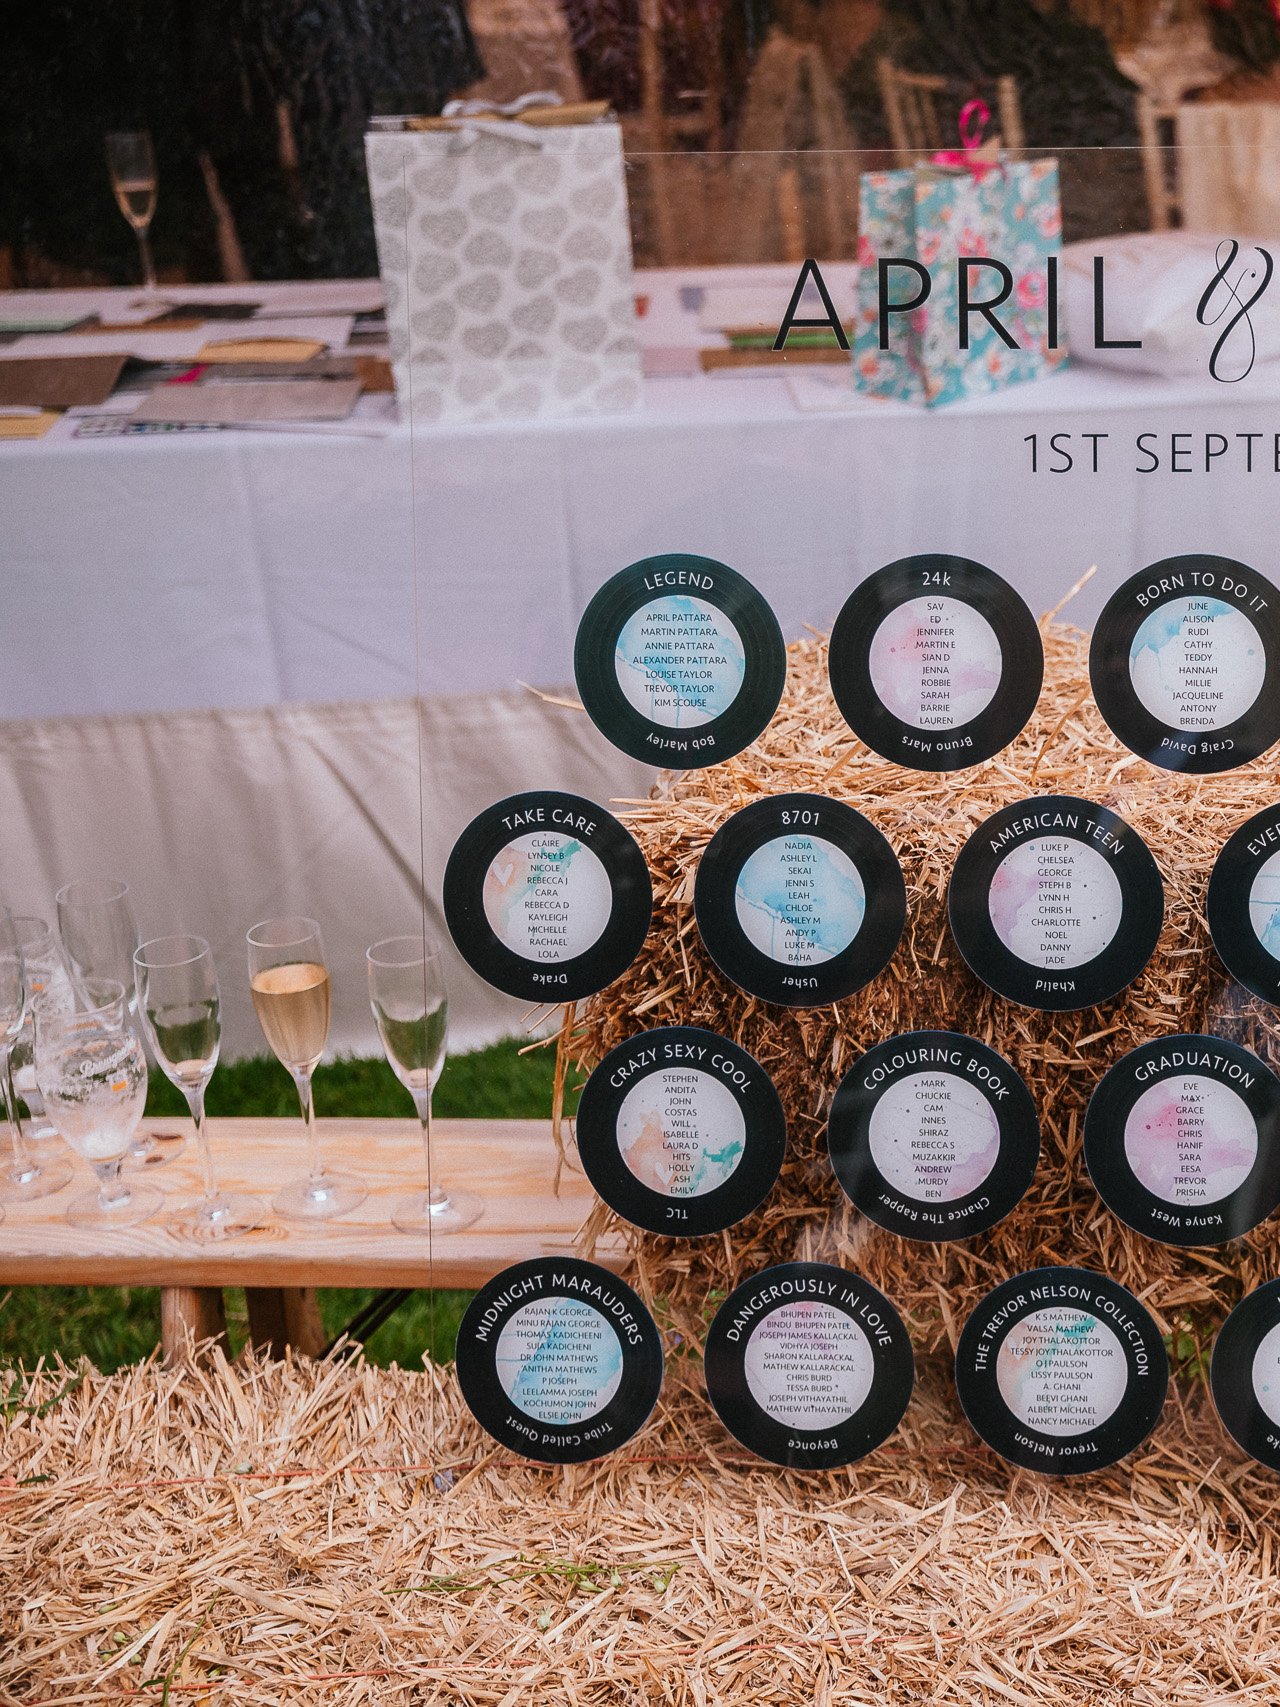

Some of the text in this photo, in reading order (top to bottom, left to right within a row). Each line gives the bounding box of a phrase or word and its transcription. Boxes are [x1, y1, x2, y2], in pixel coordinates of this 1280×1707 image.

[772, 257, 1143, 351] APRIL
[1196, 239, 1274, 384] &
[1023, 431, 1110, 474] 1ST
[644, 571, 713, 590] LEGEND
[922, 571, 951, 586] 24k
[1136, 572, 1268, 612] BORN TO DO IT
[645, 613, 713, 622] APRIL PATTARA
[916, 628, 955, 637] JENNIFER
[1178, 666, 1218, 675] HANNAH
[646, 733, 715, 751] Bob Marley
[902, 736, 973, 753] Bruno Mars
[1161, 737, 1234, 755] Craig David
[502, 808, 597, 836] TAKE CARE
[781, 810, 819, 826] 8701
[990, 813, 1124, 855] AMERICAN TEEN
[1037, 855, 1075, 865] CHELSEA
[785, 903, 814, 913] CHLOE
[528, 913, 568, 922] KAYLEIGH
[1031, 918, 1081, 927] CHARLOTTE
[532, 973, 568, 985] Drake
[782, 977, 818, 989] Usher
[1035, 980, 1075, 992] Khalid
[610, 1044, 751, 1093] CRAZY SEXY COOL
[864, 1048, 1010, 1100] COLOURING BOOK
[1135, 1052, 1255, 1088] GRADUATION
[662, 1074, 699, 1083] STEPHEN
[915, 1091, 952, 1101] CHUCKIE
[663, 1130, 699, 1139] ISABELLE
[912, 1153, 956, 1162] MUZAKKIR
[1173, 1176, 1207, 1185] TREVOR
[666, 1207, 688, 1219] TLC
[878, 1194, 990, 1224] Chance The Rapper
[1151, 1208, 1222, 1227] Kanye West
[475, 1274, 643, 1345] MIDNIGHT MARAUDERS
[726, 1279, 892, 1346] DANGEROUSLY IN LOVE
[975, 1285, 1148, 1375] THE TREVOR NELSON COLLECTION
[785, 1373, 833, 1383] CHRIS BURD
[1030, 1370, 1094, 1381] LISSY PAULSON
[522, 1387, 598, 1398] LEELAMMA JOSEPH
[506, 1416, 613, 1446] Tribe Called Quest
[788, 1439, 838, 1450] Beyonce
[1014, 1433, 1098, 1456] Trevor Nelson
